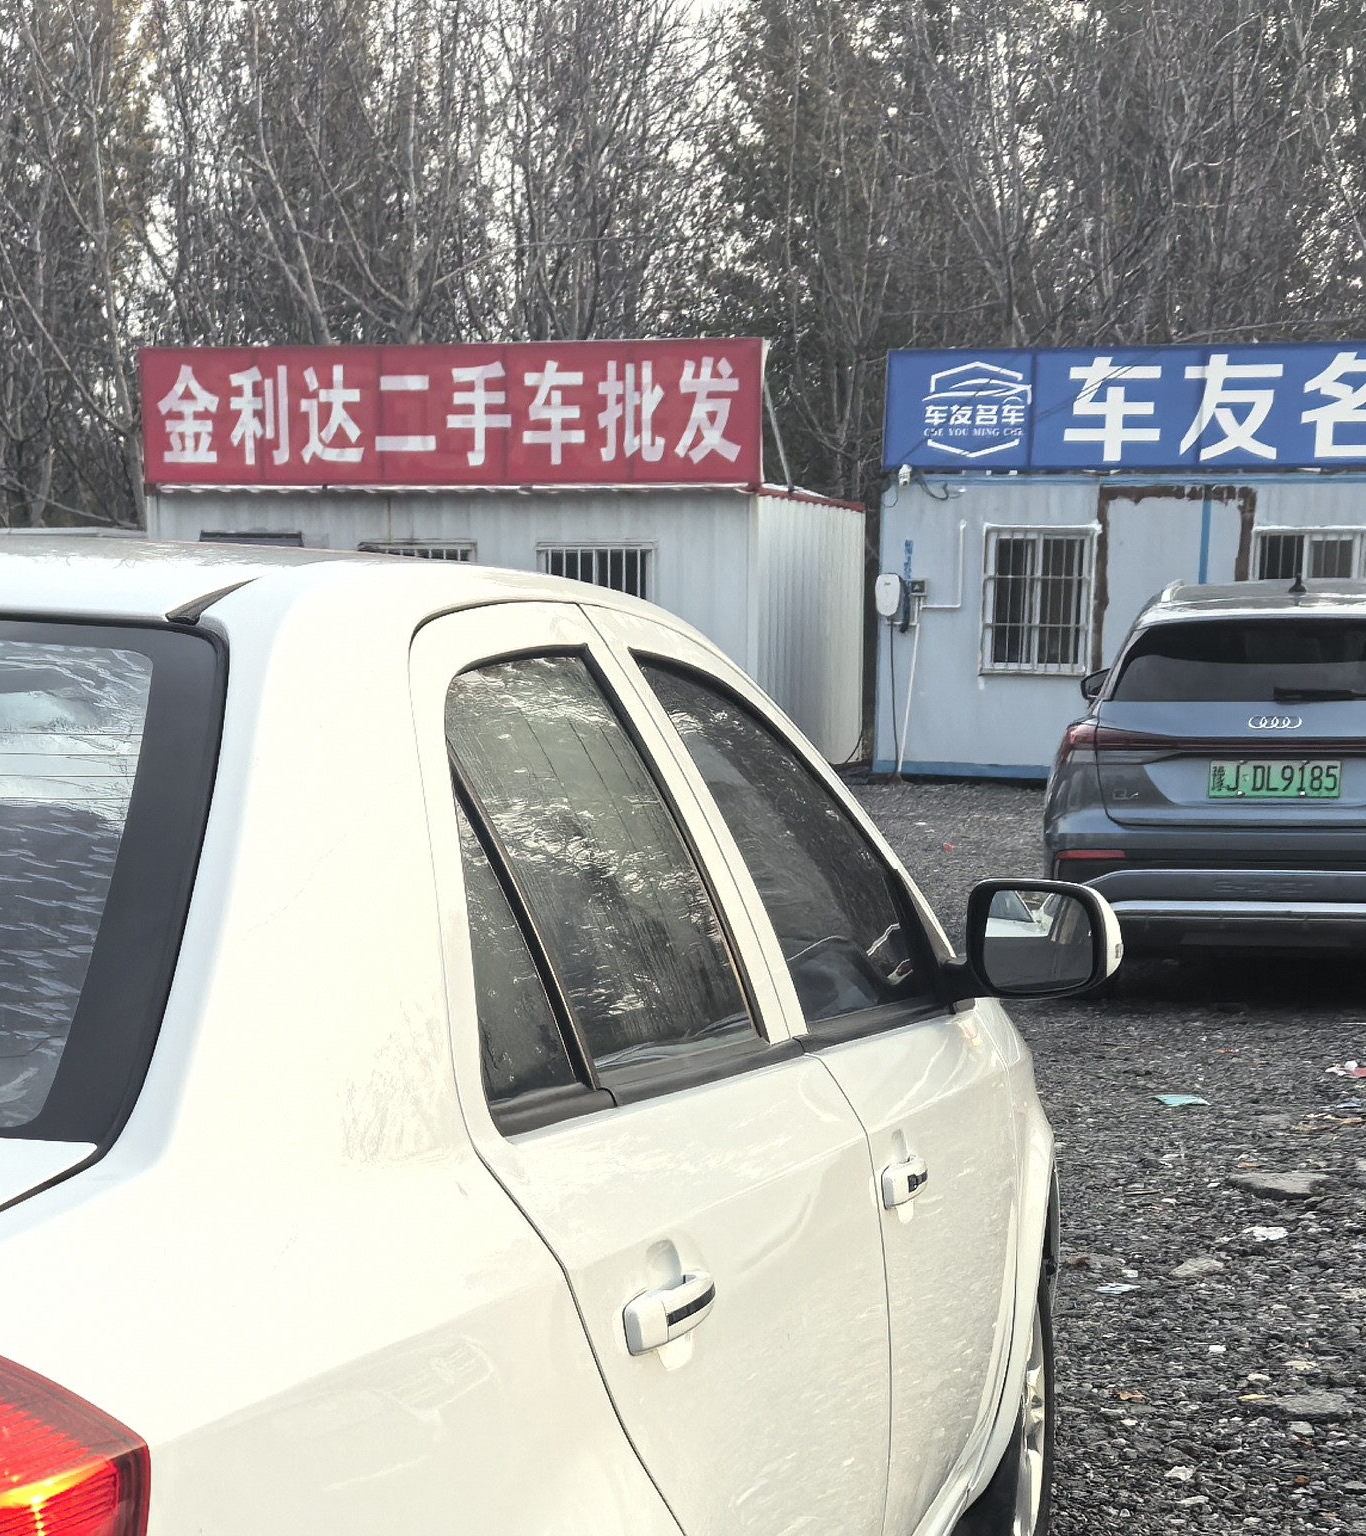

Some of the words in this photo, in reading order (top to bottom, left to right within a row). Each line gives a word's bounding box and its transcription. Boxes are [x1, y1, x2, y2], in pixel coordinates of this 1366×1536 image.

[156, 355, 742, 468] 金利达二手车批发
[924, 404, 1026, 426] 车友名车
[948, 427, 969, 437] YOU
[972, 427, 1000, 437] MING
